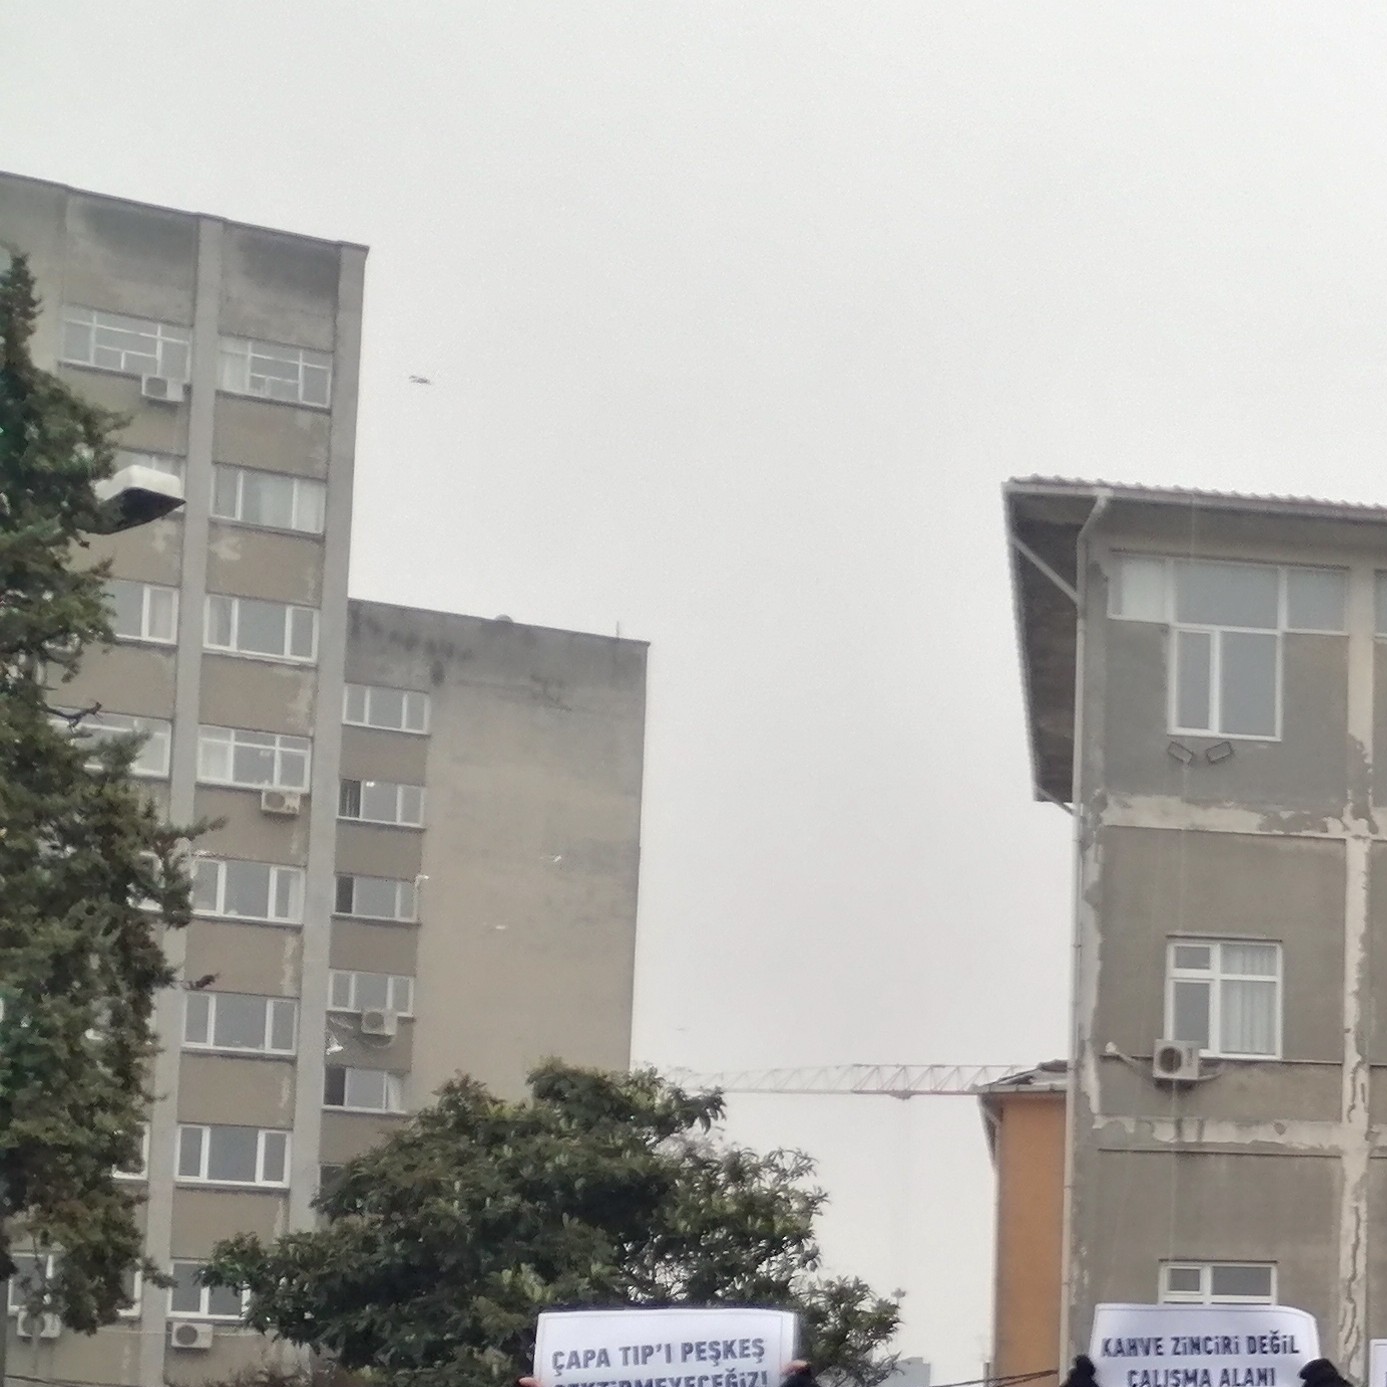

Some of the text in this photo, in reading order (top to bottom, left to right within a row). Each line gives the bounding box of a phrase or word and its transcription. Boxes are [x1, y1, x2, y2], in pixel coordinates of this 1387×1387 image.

[552, 1348, 611, 1377] ÇAPA
[680, 1337, 766, 1367] PEŞKEŞ
[1101, 1337, 1164, 1357] KAHVE
[1219, 1367, 1277, 1387] ALANI
